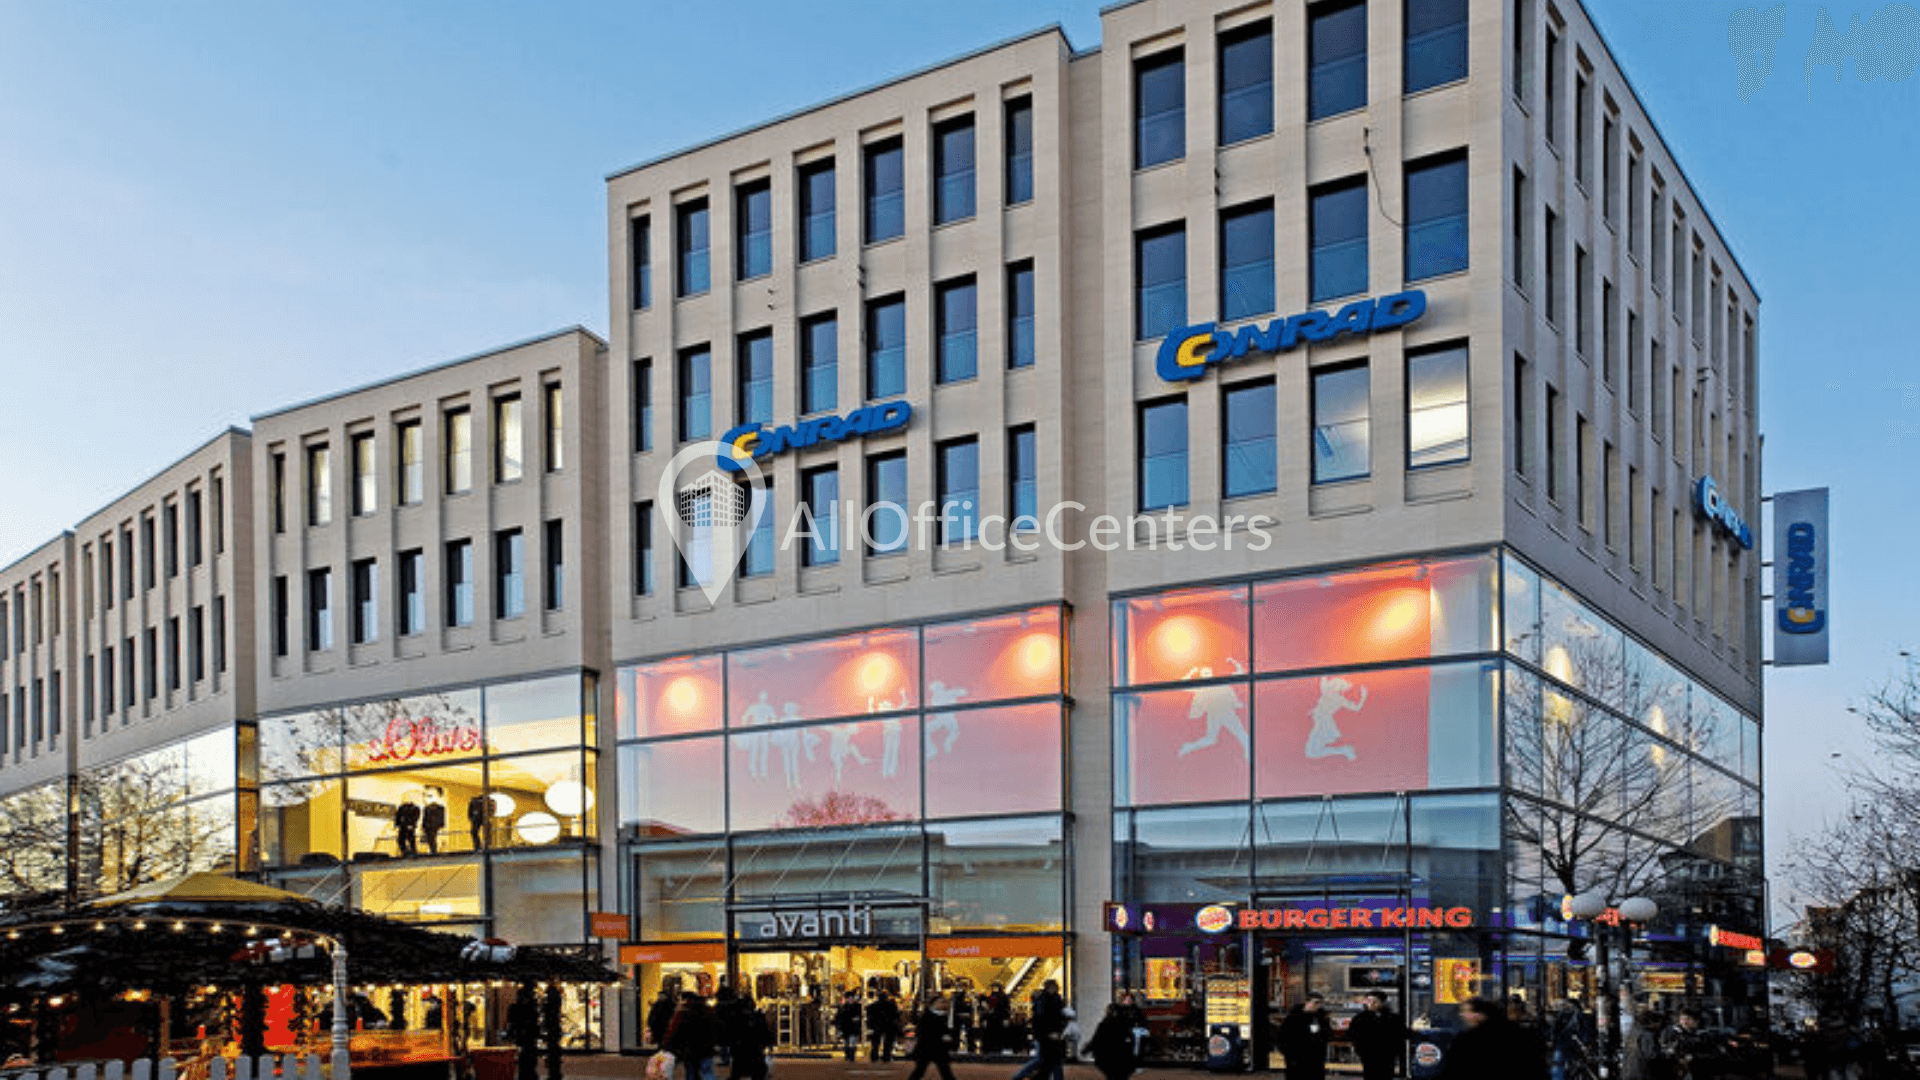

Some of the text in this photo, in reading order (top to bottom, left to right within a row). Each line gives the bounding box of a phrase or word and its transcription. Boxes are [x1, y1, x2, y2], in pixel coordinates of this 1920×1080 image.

[1157, 290, 1427, 382] CONRAD
[717, 400, 914, 471] CONRAD
[760, 903, 873, 937] avanti
[1238, 908, 1373, 928] BURGER
[1381, 907, 1473, 928] KING
